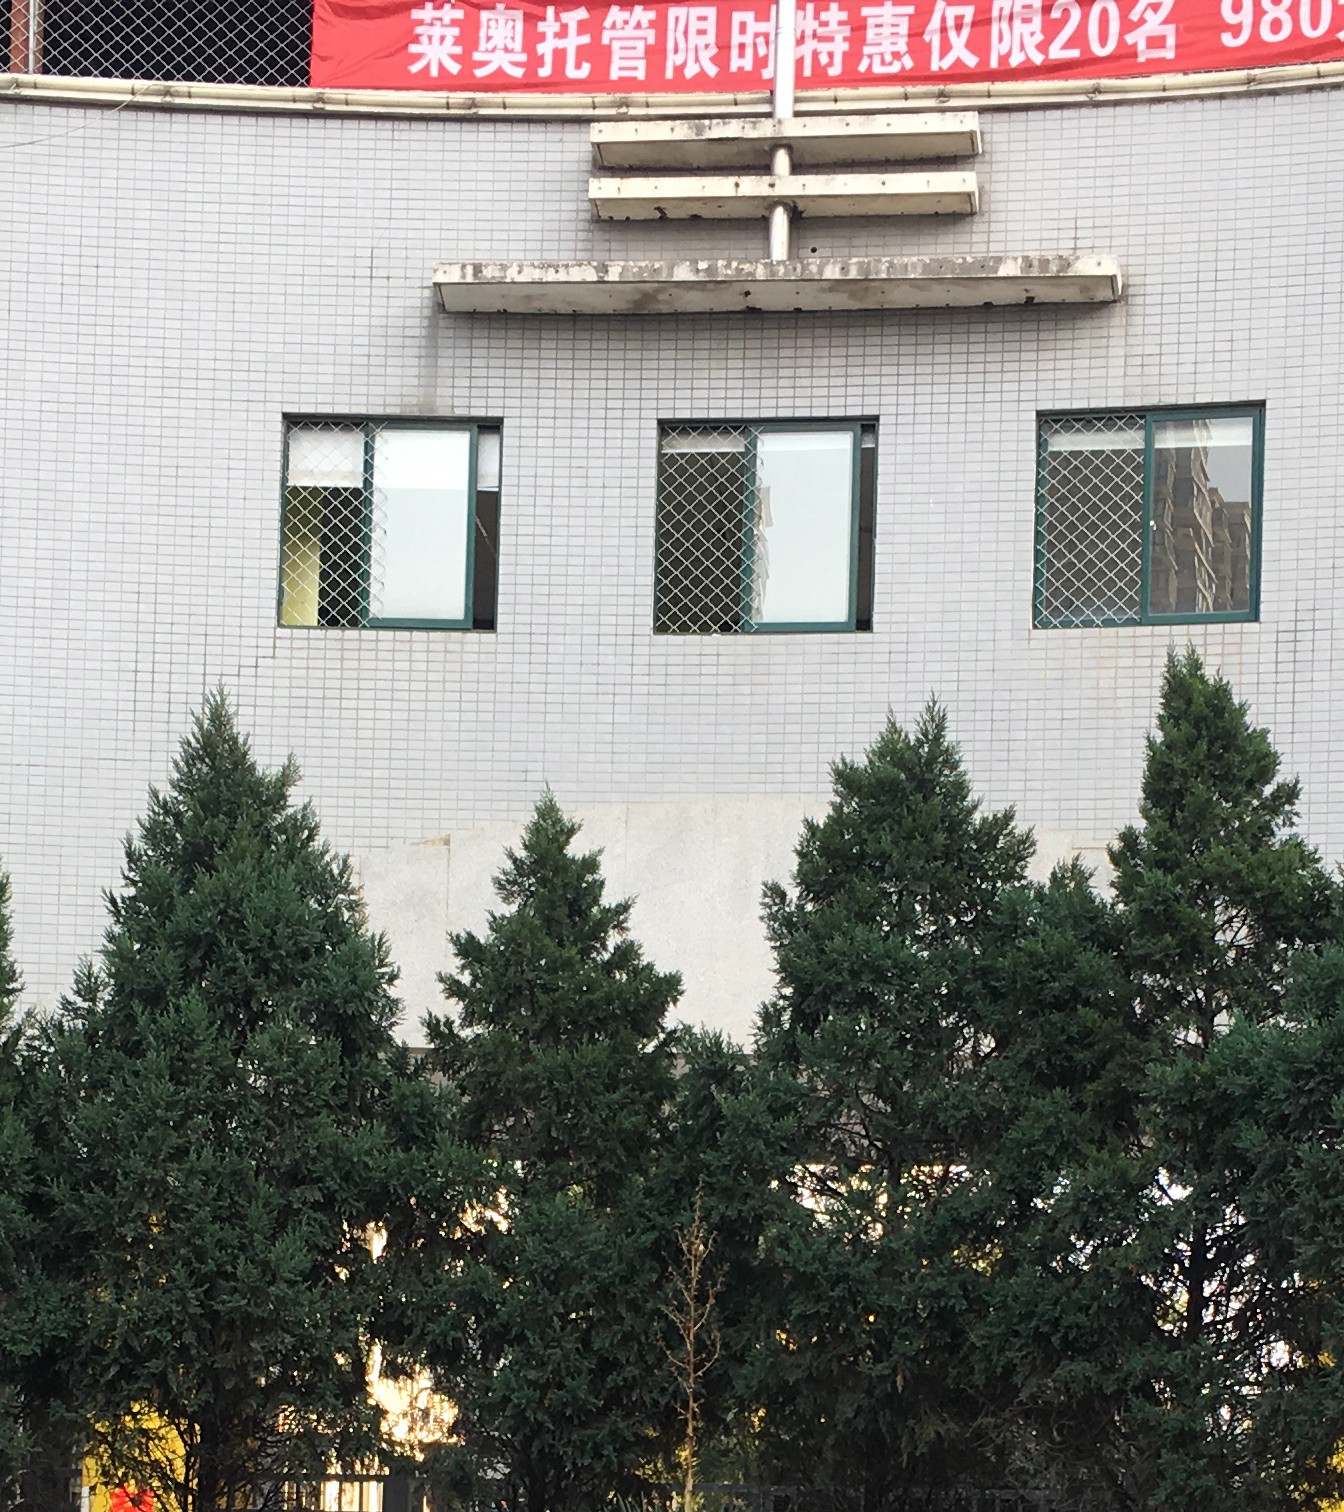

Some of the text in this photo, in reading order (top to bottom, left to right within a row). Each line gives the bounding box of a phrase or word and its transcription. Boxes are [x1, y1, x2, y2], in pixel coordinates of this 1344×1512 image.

[407, 0, 1177, 80] 莱奥托管限时特惠仅限20名
